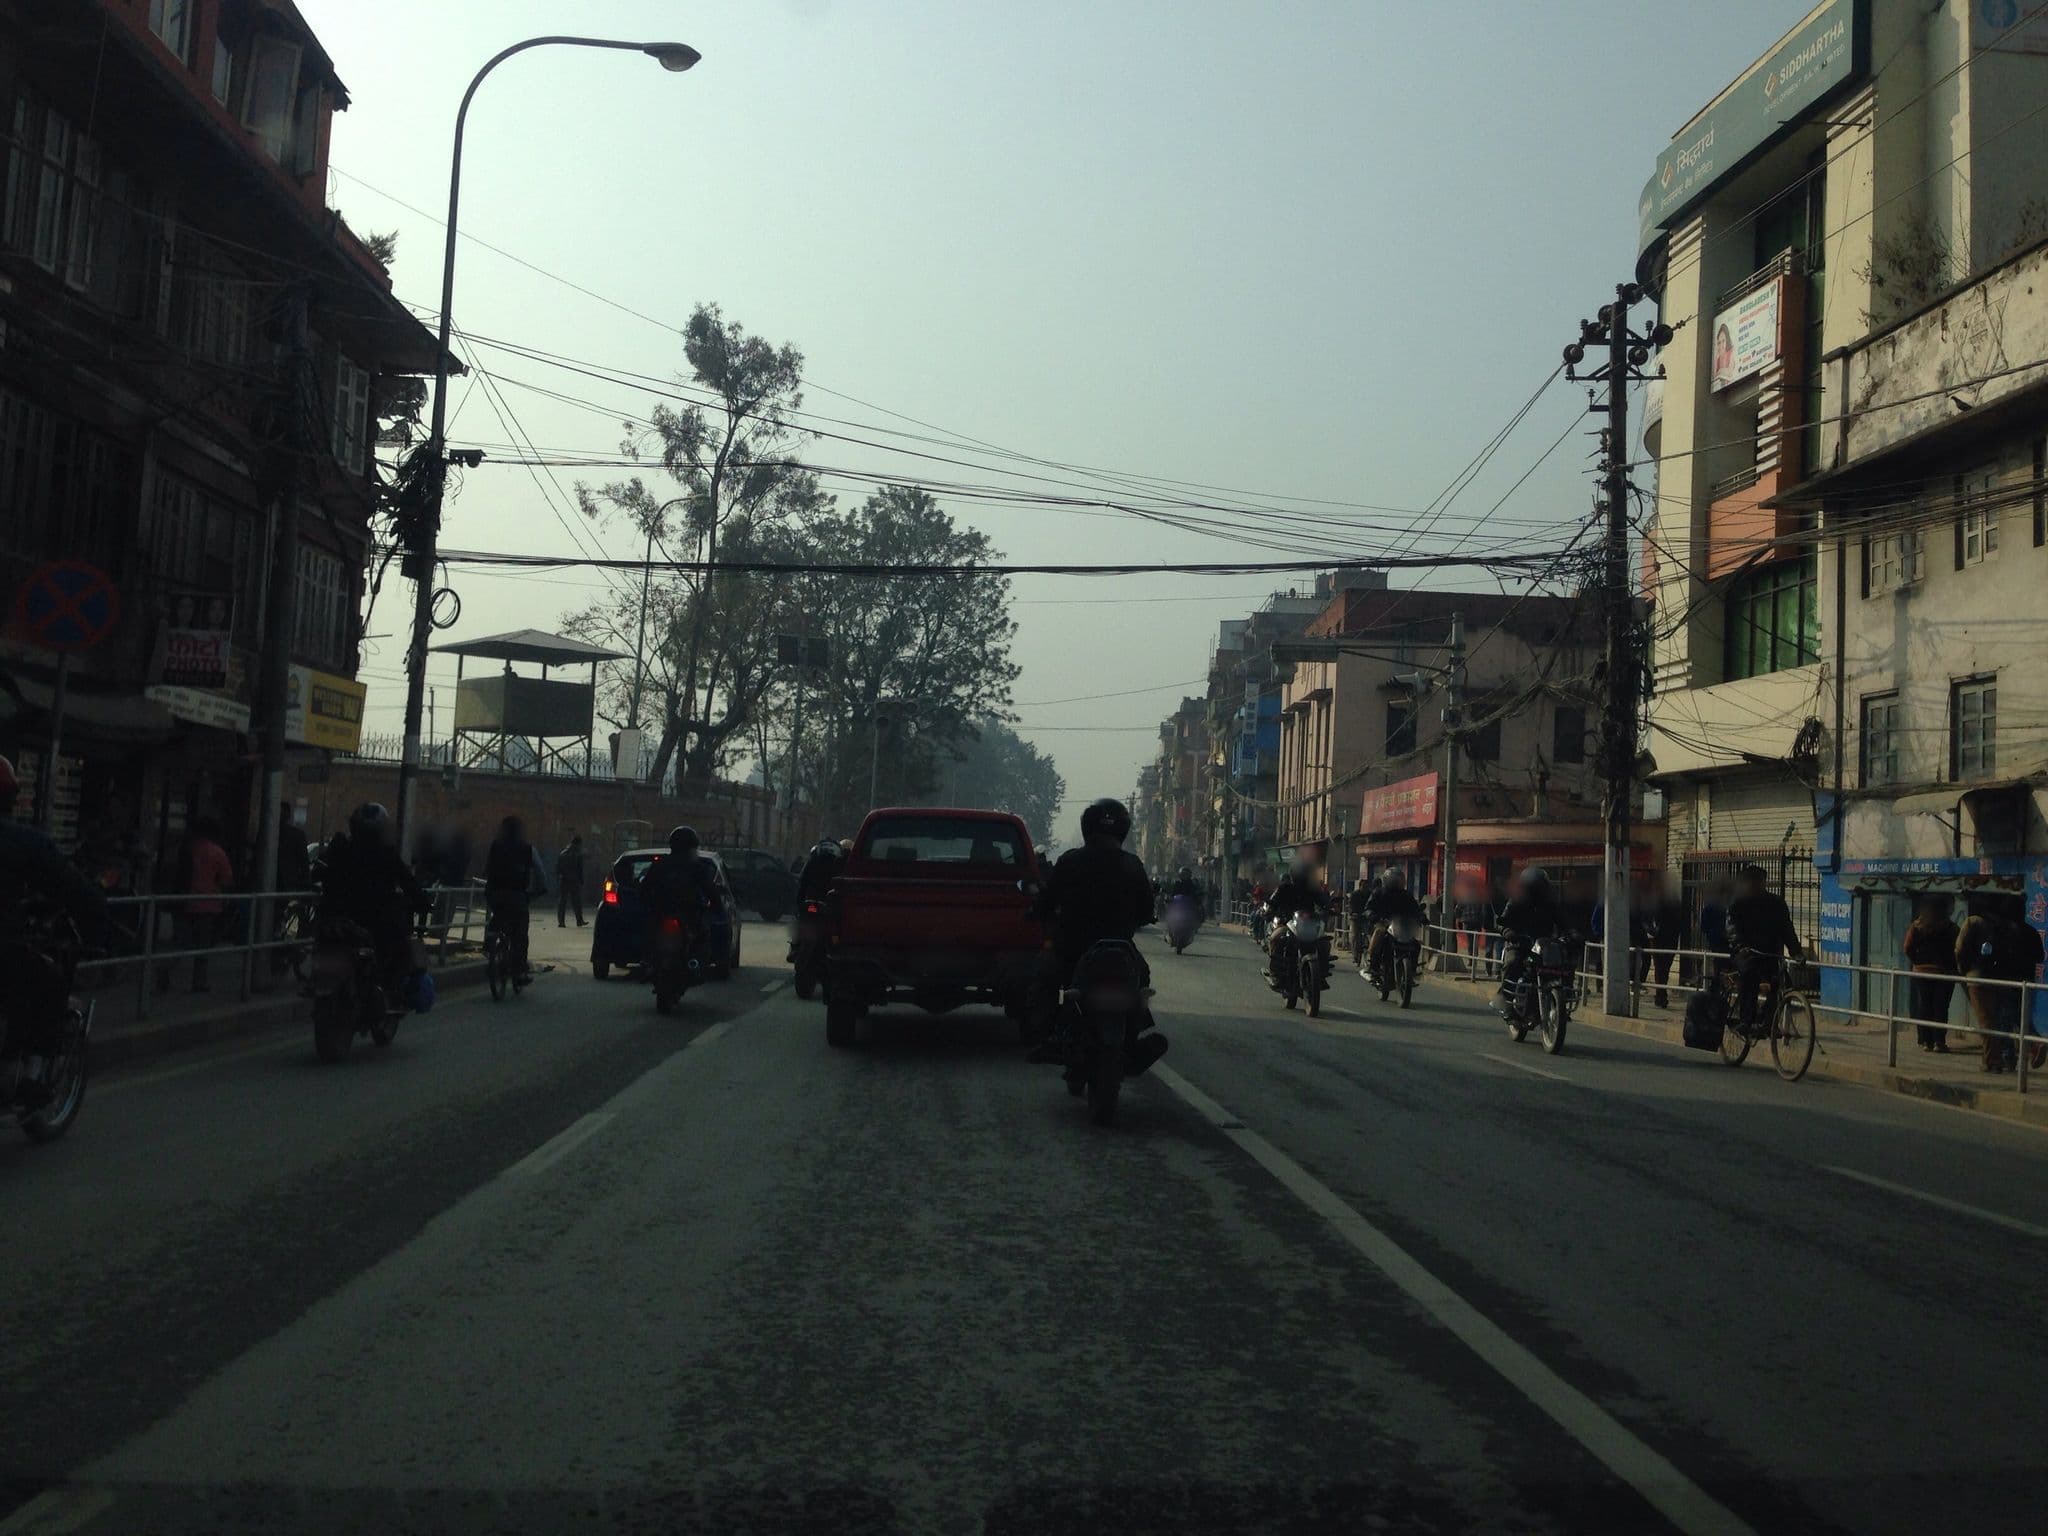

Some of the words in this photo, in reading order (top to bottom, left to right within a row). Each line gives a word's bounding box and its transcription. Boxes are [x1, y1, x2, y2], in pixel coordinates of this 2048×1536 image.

[1780, 19, 1845, 86] SIDDHARTHA
[1867, 863, 1900, 874] MACHINE
[1901, 862, 1940, 874] AVAILABLE
